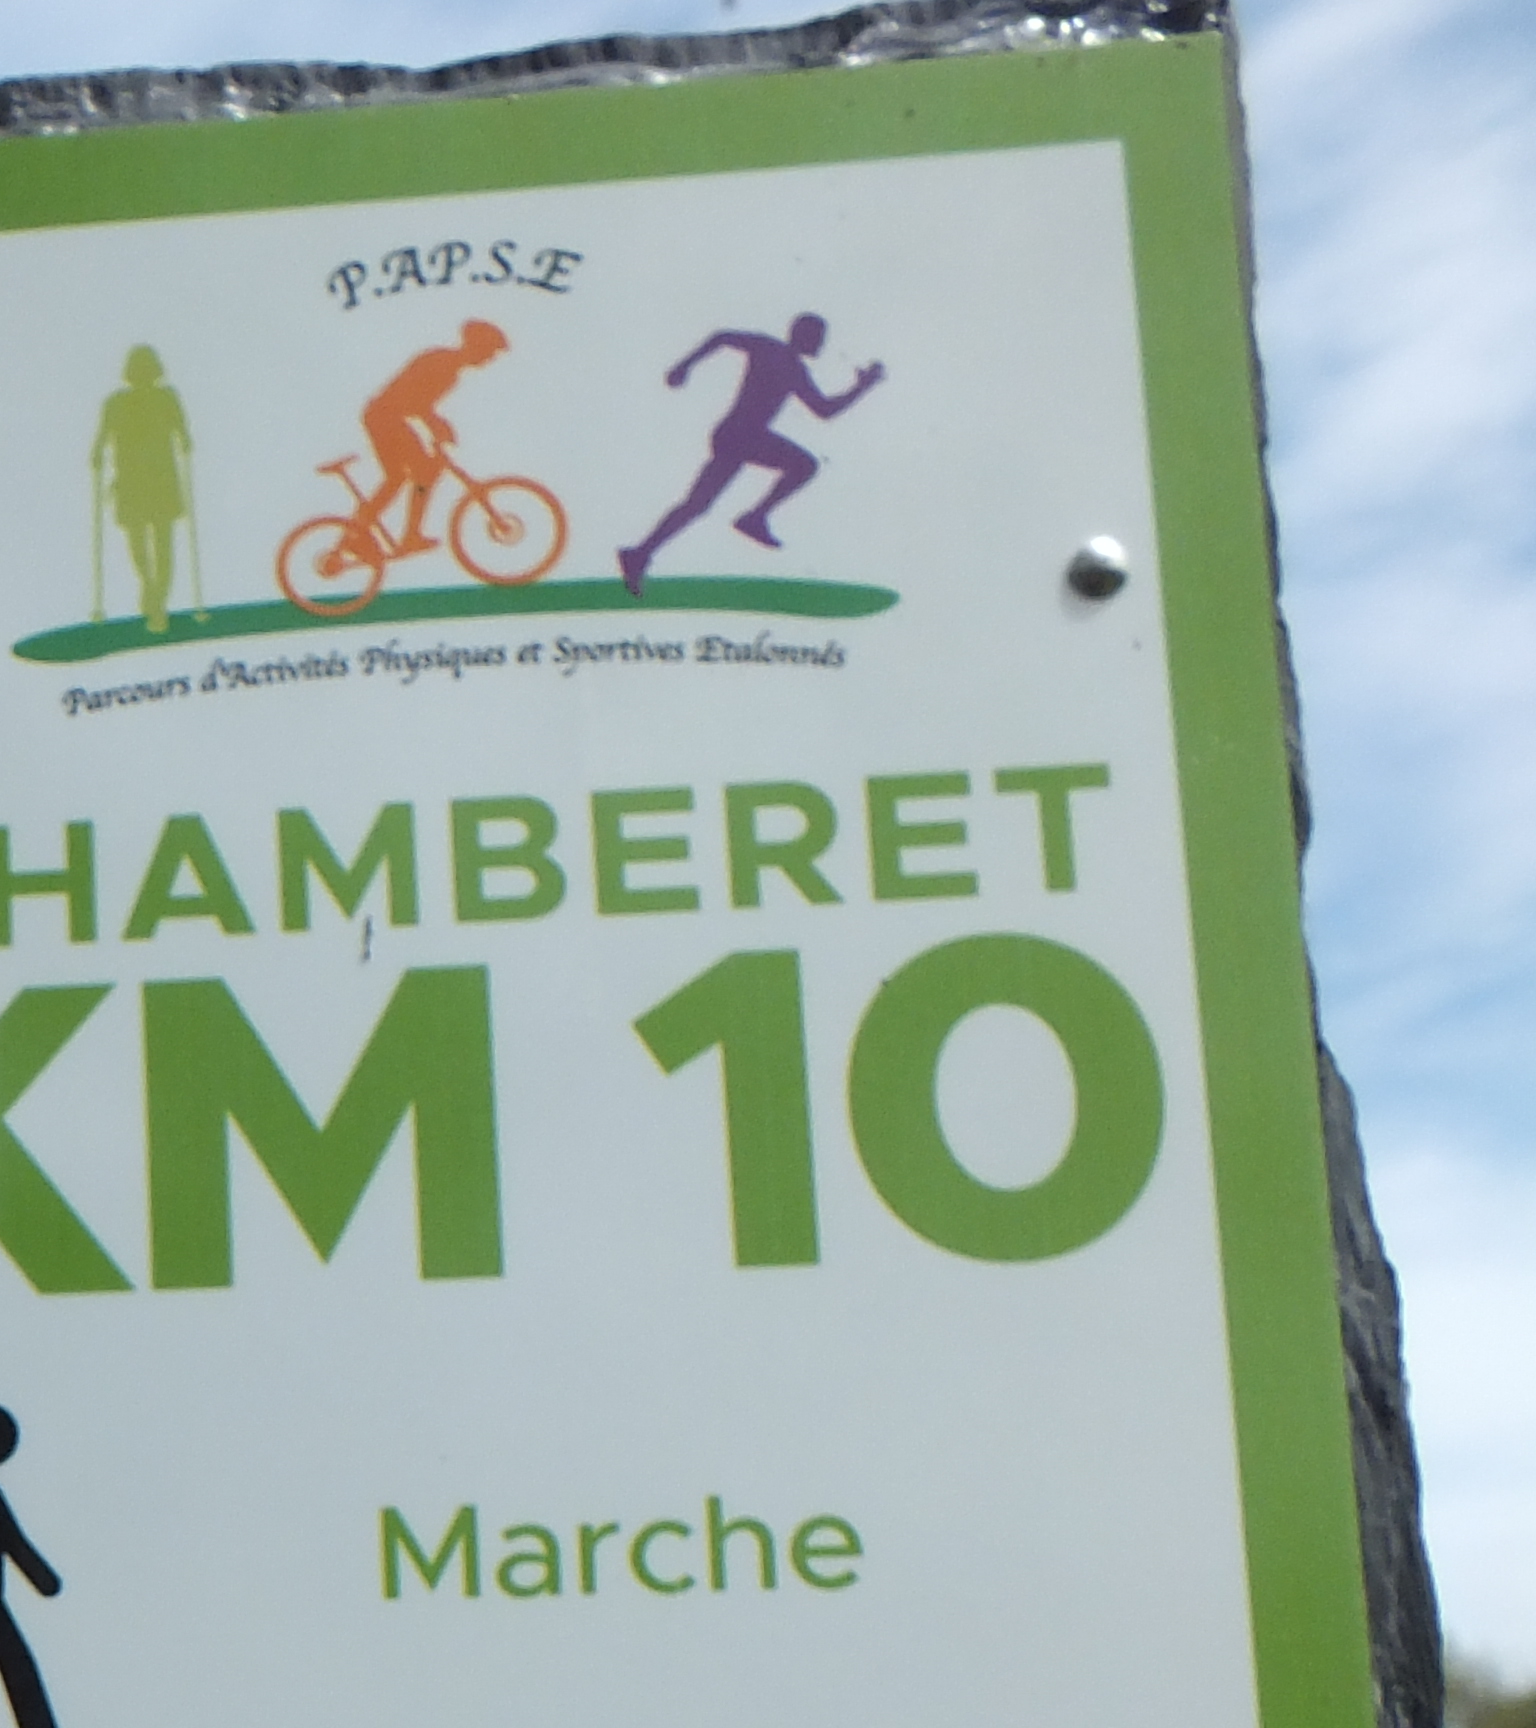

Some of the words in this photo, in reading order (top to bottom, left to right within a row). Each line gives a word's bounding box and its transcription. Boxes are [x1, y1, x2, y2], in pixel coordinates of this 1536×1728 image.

[62, 676, 192, 716] Parcours
[198, 652, 350, 693] d'Activités
[358, 638, 508, 685] Physiques
[516, 641, 544, 664] et
[552, 634, 686, 677] Sportives
[634, 937, 1162, 1268] 10
[378, 1498, 862, 1600] Marche
